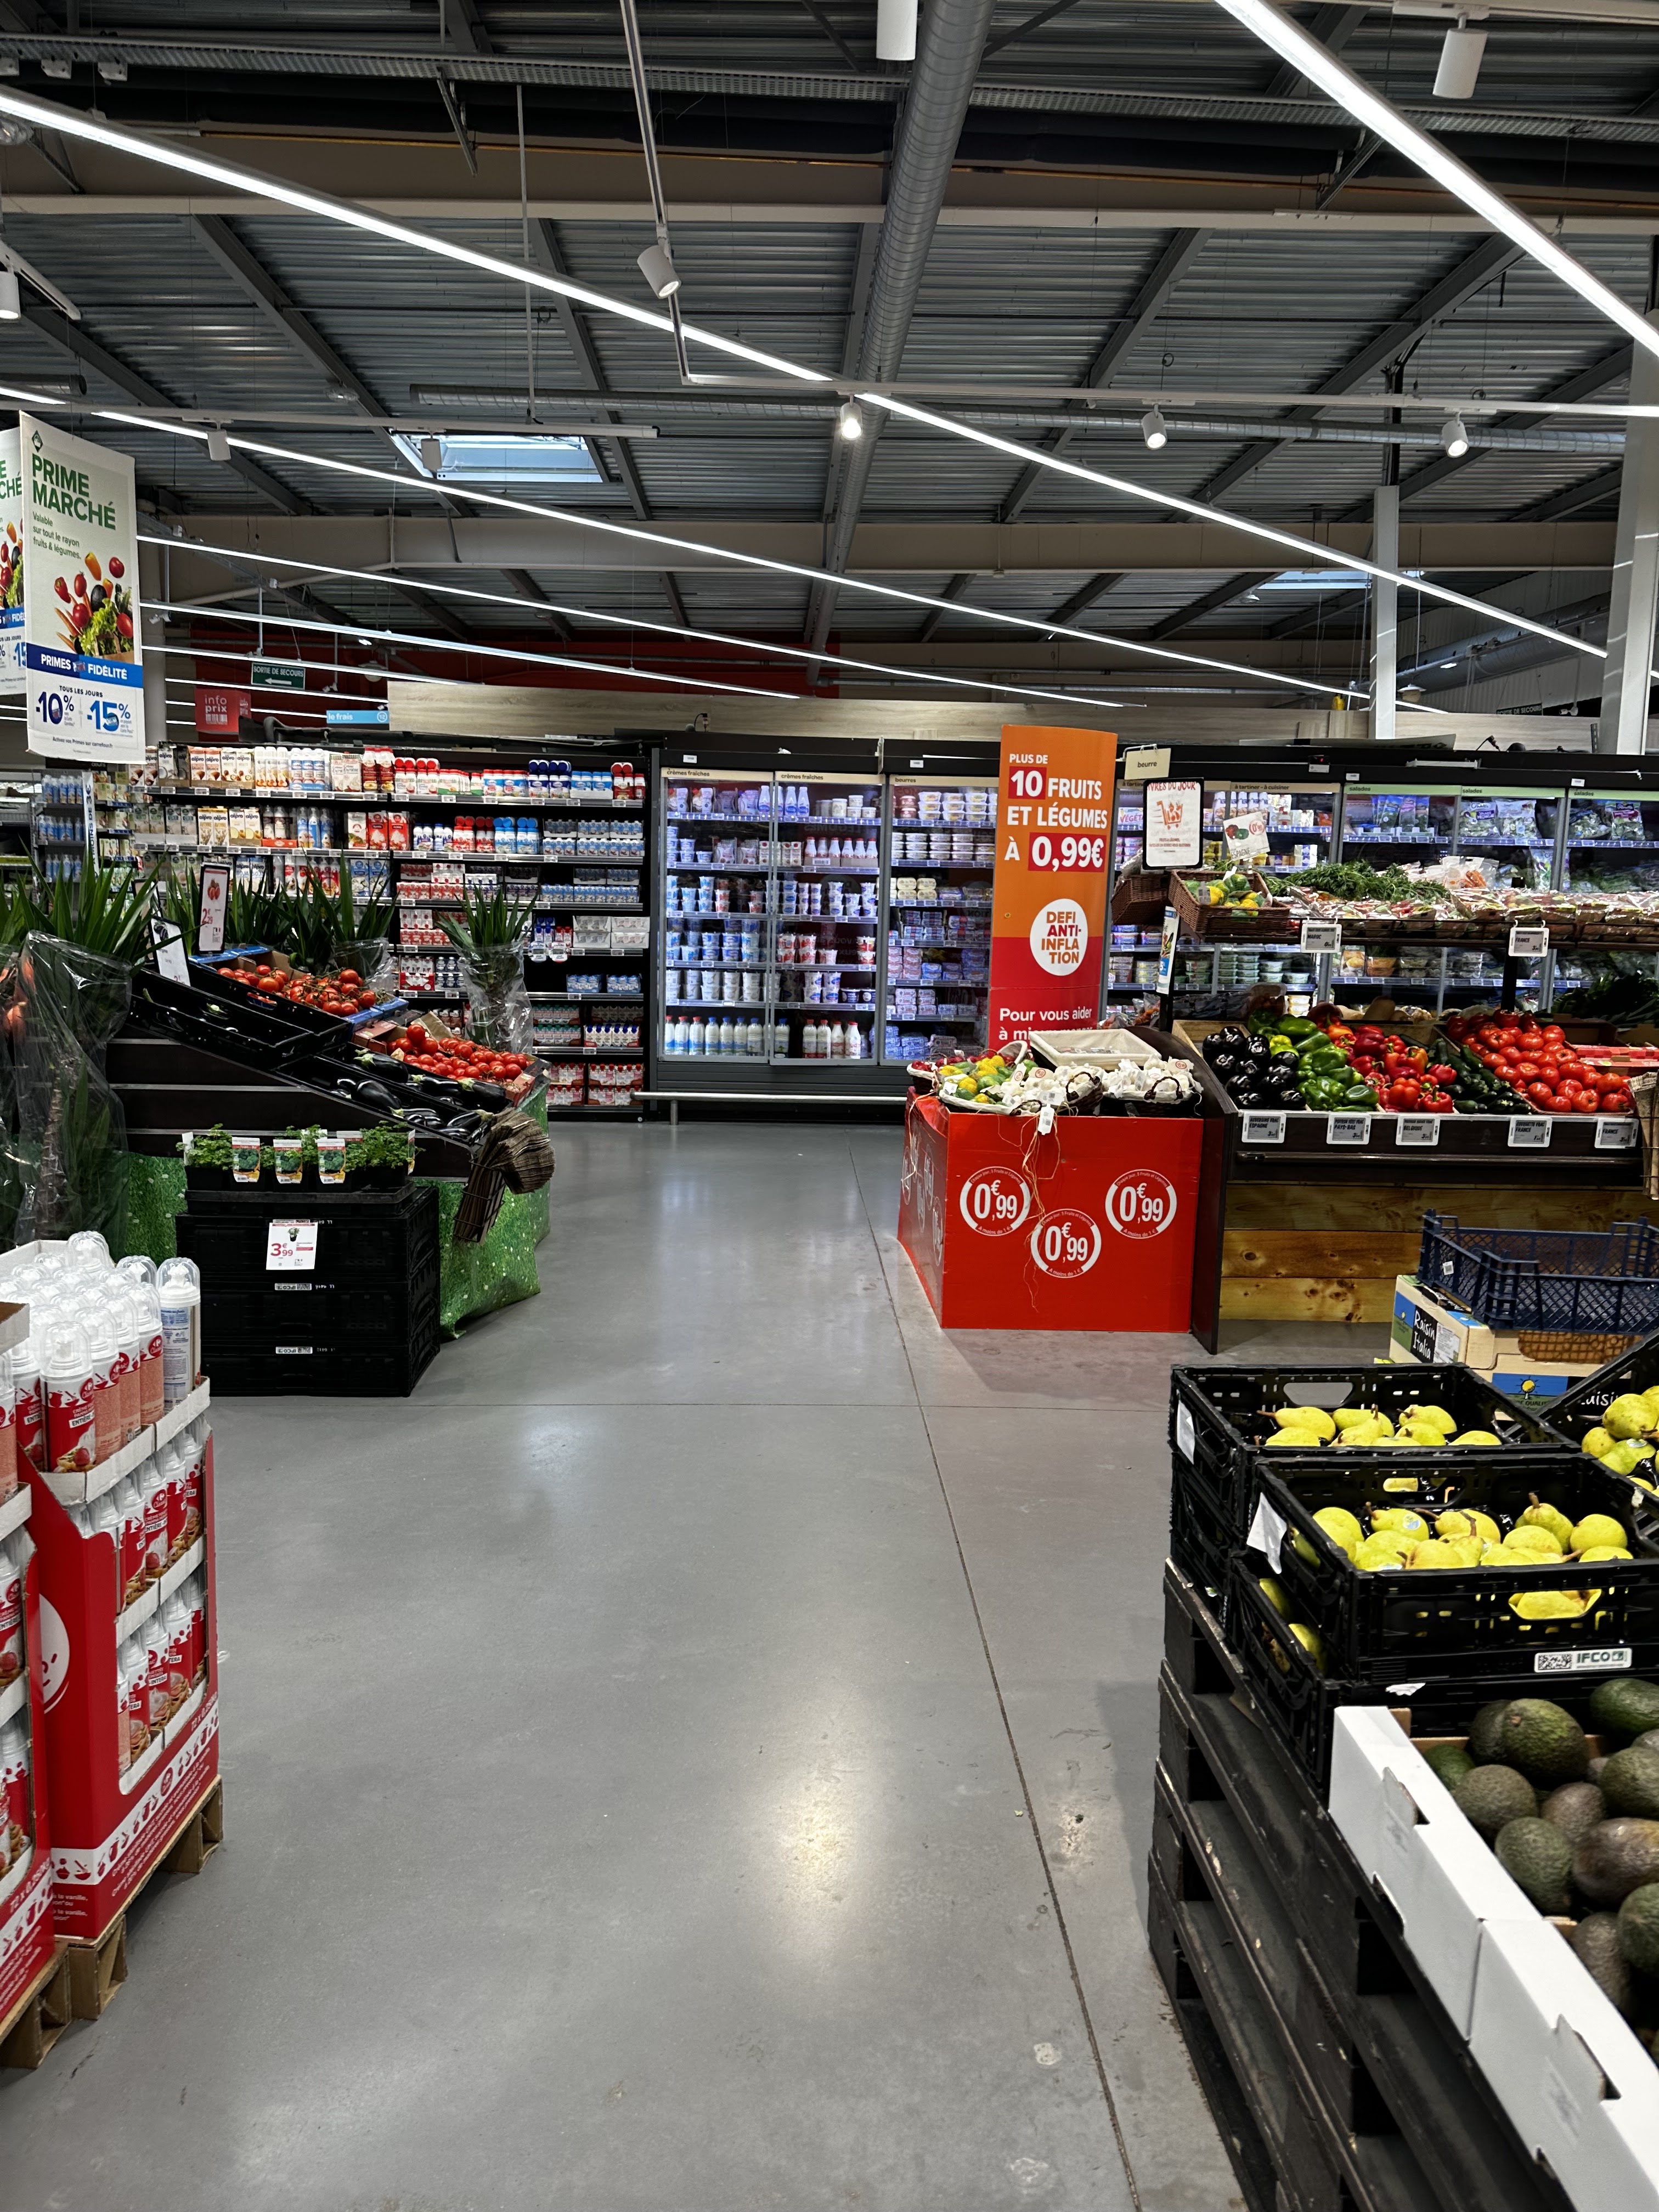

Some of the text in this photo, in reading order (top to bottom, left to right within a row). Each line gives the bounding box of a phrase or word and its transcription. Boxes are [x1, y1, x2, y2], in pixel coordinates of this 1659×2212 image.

[32, 453, 89, 498] PRIME
[33, 479, 116, 530] MARCHÉ
[33, 511, 53, 527] Valable
[33, 526, 80, 548] sur tout le rayon
[33, 537, 48, 549] fruits
[41, 653, 127, 680] PRIMES FIDÉLITÉ
[253, 666, 271, 674] SORTIE
[280, 668, 304, 677] SECOURS
[74, 687, 84, 695] LES
[85, 689, 103, 698] JOURS
[205, 695, 227, 706] info
[36, 691, 75, 725] -10%
[205, 705, 227, 713] prix
[87, 700, 131, 732] -15%
[1009, 754, 1048, 764] PLUS DE
[1011, 770, 1102, 800] 10 FRUITS
[1168, 782, 1177, 790] DU
[1007, 802, 1107, 829] ET LÉGUMES
[1004, 836, 1104, 872] À 0,99€
[1231, 848, 1250, 859] ESPAGNE
[1046, 911, 1076, 924] DEFI
[1047, 925, 1081, 936] ANTI-
[1041, 938, 1080, 951] INFLA
[1049, 951, 1080, 964] TION
[1000, 1006, 1092, 1021] Pour vous aider
[998, 1026, 1008, 1040] à
[1414, 1310, 1435, 1341] Raisin
[1413, 1331, 1431, 1359] Italia
[1577, 1652, 1611, 1664] IFCO
